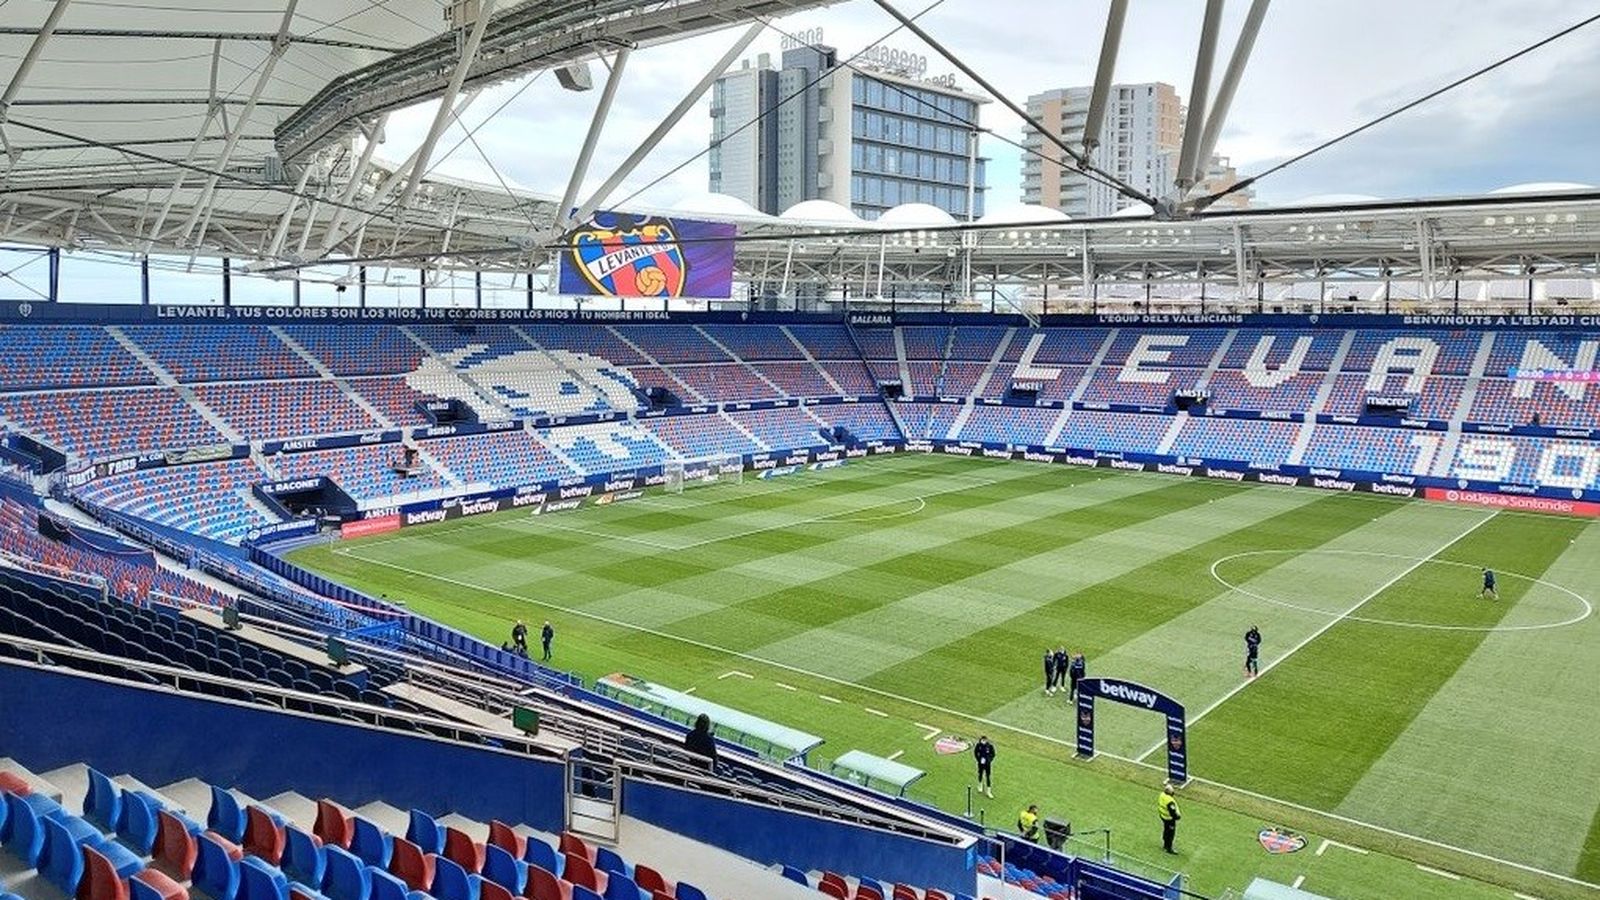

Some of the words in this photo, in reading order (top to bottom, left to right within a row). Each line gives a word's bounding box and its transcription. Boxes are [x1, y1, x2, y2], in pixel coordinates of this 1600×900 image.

[598, 246, 651, 275] LEVANTE
[157, 306, 230, 319] LEVANTE,
[235, 307, 261, 318] TUS
[266, 307, 328, 318] COLORES
[331, 308, 358, 319] SON
[361, 308, 385, 319] LOS
[423, 308, 446, 319] TUS
[500, 310, 522, 320] SON
[523, 310, 543, 320] LOS
[570, 311, 578, 319] Y
[580, 311, 592, 320] TU
[594, 311, 632, 320] NOMBRE
[633, 311, 644, 320] MI
[645, 311, 670, 320] IDEAL
[1099, 315, 1140, 323] L'EQUIP
[1142, 315, 1170, 323] DELS
[1172, 315, 1244, 324] VALENCIANS
[1403, 316, 1492, 325] BENVINGUTS
[1495, 317, 1507, 325] A
[1510, 316, 1575, 326] L'ESTADI
[1367, 397, 1412, 406] macron
[1333, 414, 1359, 423] betway
[1401, 418, 1428, 427] betway
[283, 440, 317, 450] AMSTEL
[904, 443, 934, 453] betway
[944, 445, 973, 456] betway
[983, 448, 1013, 460] betway
[1024, 452, 1055, 464] betway
[1066, 455, 1098, 468] betway
[1111, 459, 1145, 472] betway
[1158, 462, 1193, 477] betway
[1207, 467, 1245, 481] betway
[1310, 467, 1341, 478] betway
[276, 478, 321, 491] RACONET
[605, 479, 635, 491] betway
[1259, 472, 1298, 486] betway
[1314, 477, 1356, 491] betway
[1382, 474, 1416, 484] betway
[560, 486, 593, 498] betway
[1372, 482, 1416, 497] betway
[513, 493, 548, 506] betway
[1509, 496, 1574, 512] Santander
[462, 500, 499, 515] betway
[408, 509, 447, 524] betway
[1100, 680, 1157, 708] betway
